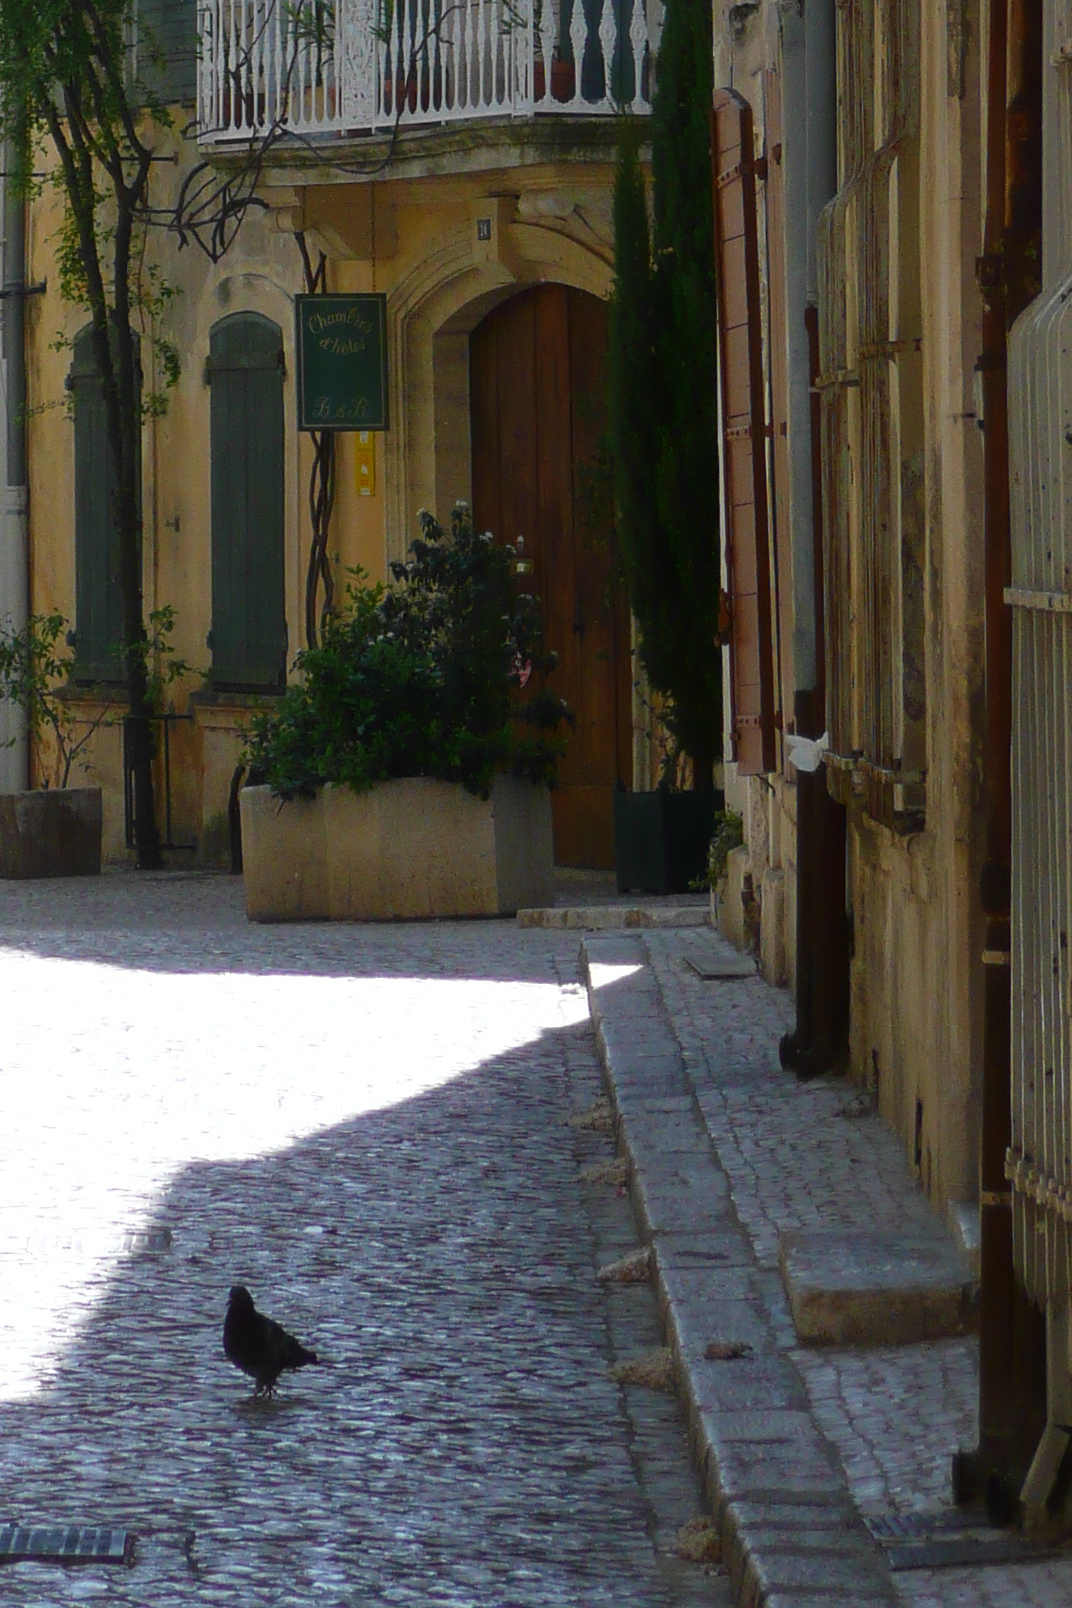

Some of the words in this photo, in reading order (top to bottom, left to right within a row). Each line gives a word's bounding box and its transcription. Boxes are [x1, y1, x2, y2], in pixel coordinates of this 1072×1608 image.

[307, 306, 372, 333] Chambres
[314, 396, 332, 419] B
[348, 396, 368, 419] B
